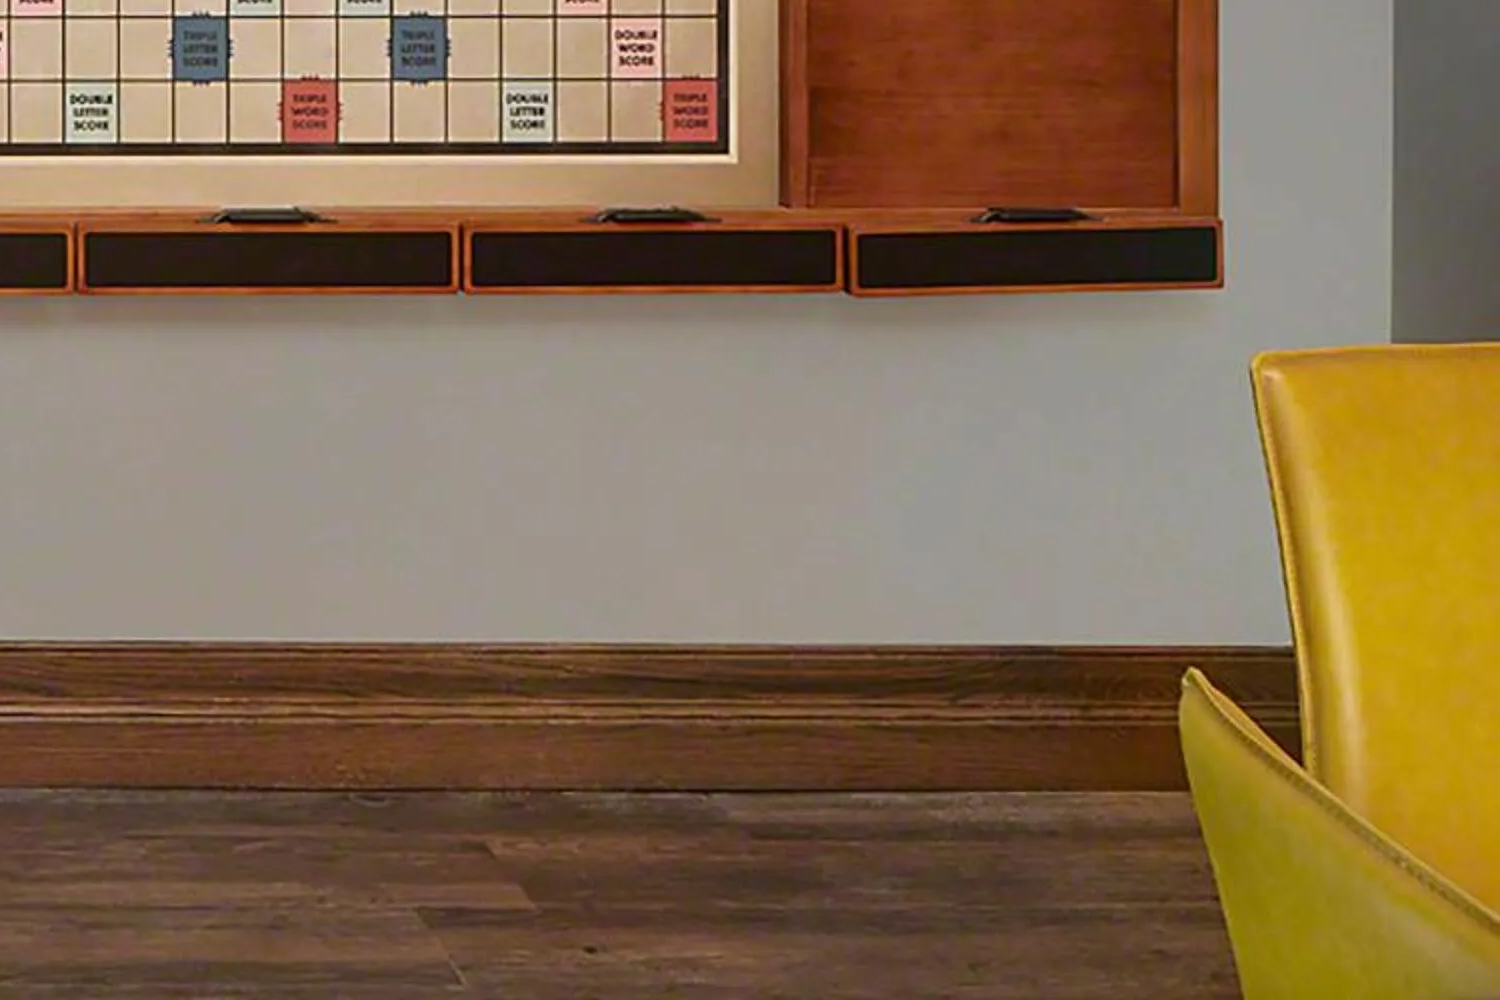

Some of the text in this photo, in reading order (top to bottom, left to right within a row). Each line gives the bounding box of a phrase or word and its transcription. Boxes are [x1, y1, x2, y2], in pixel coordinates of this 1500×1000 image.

[614, 29, 658, 41] DOUBLE
[617, 43, 656, 54] WORD
[618, 55, 655, 67] SCORE
[69, 93, 113, 105] DOUBLE
[505, 93, 549, 105] DOUBLE
[72, 107, 110, 118] LETTER
[509, 106, 546, 117] LETTER
[73, 120, 109, 131] SCORE
[510, 119, 546, 130] SCORE
